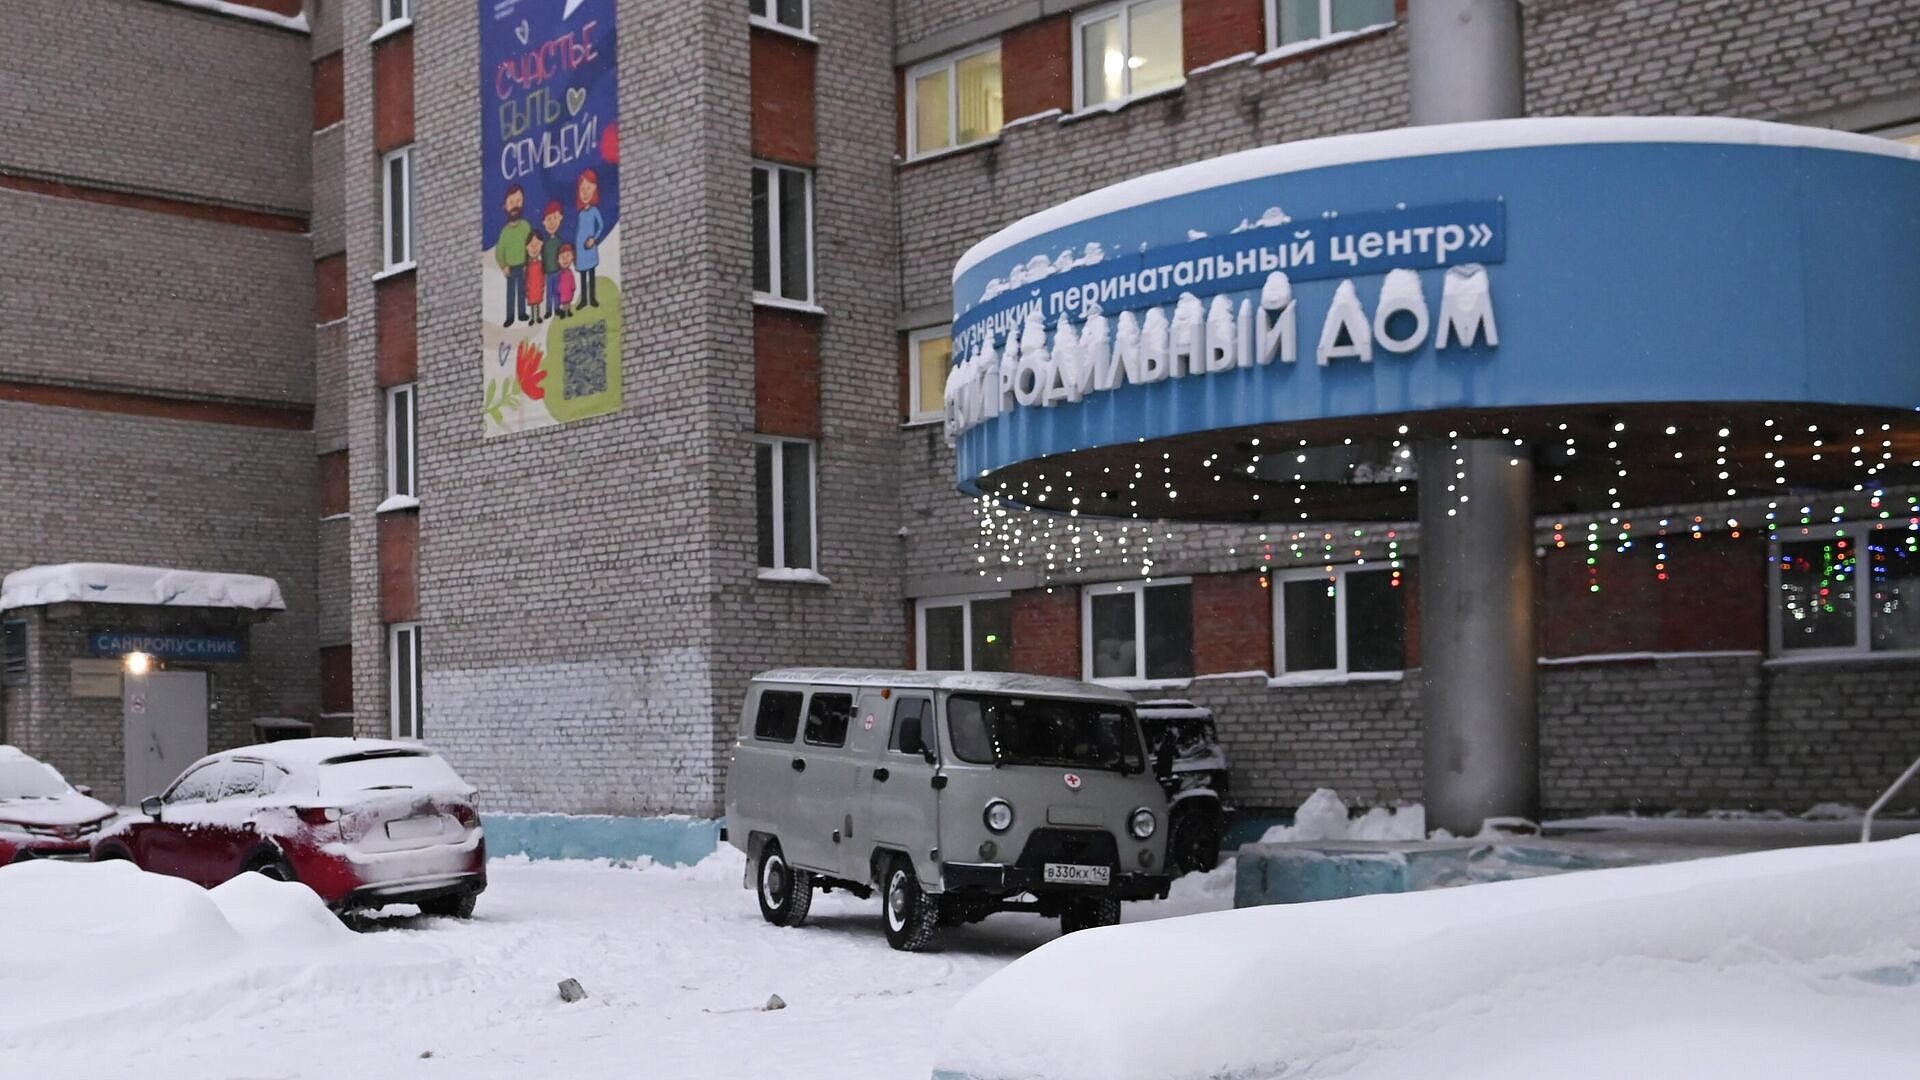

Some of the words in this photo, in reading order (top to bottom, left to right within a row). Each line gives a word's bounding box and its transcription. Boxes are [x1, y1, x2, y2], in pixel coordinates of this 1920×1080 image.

[496, 21, 598, 99] СЧАСТЬЕ
[500, 87, 560, 141] БЫТЬ
[501, 112, 597, 180] СЕМЬЕЙ!
[1050, 229, 1315, 319] перинатальный
[1330, 223, 1494, 264] центр»
[1317, 266, 1500, 367] ДОМ
[97, 635, 237, 653] САНПРОПУСКНИК
